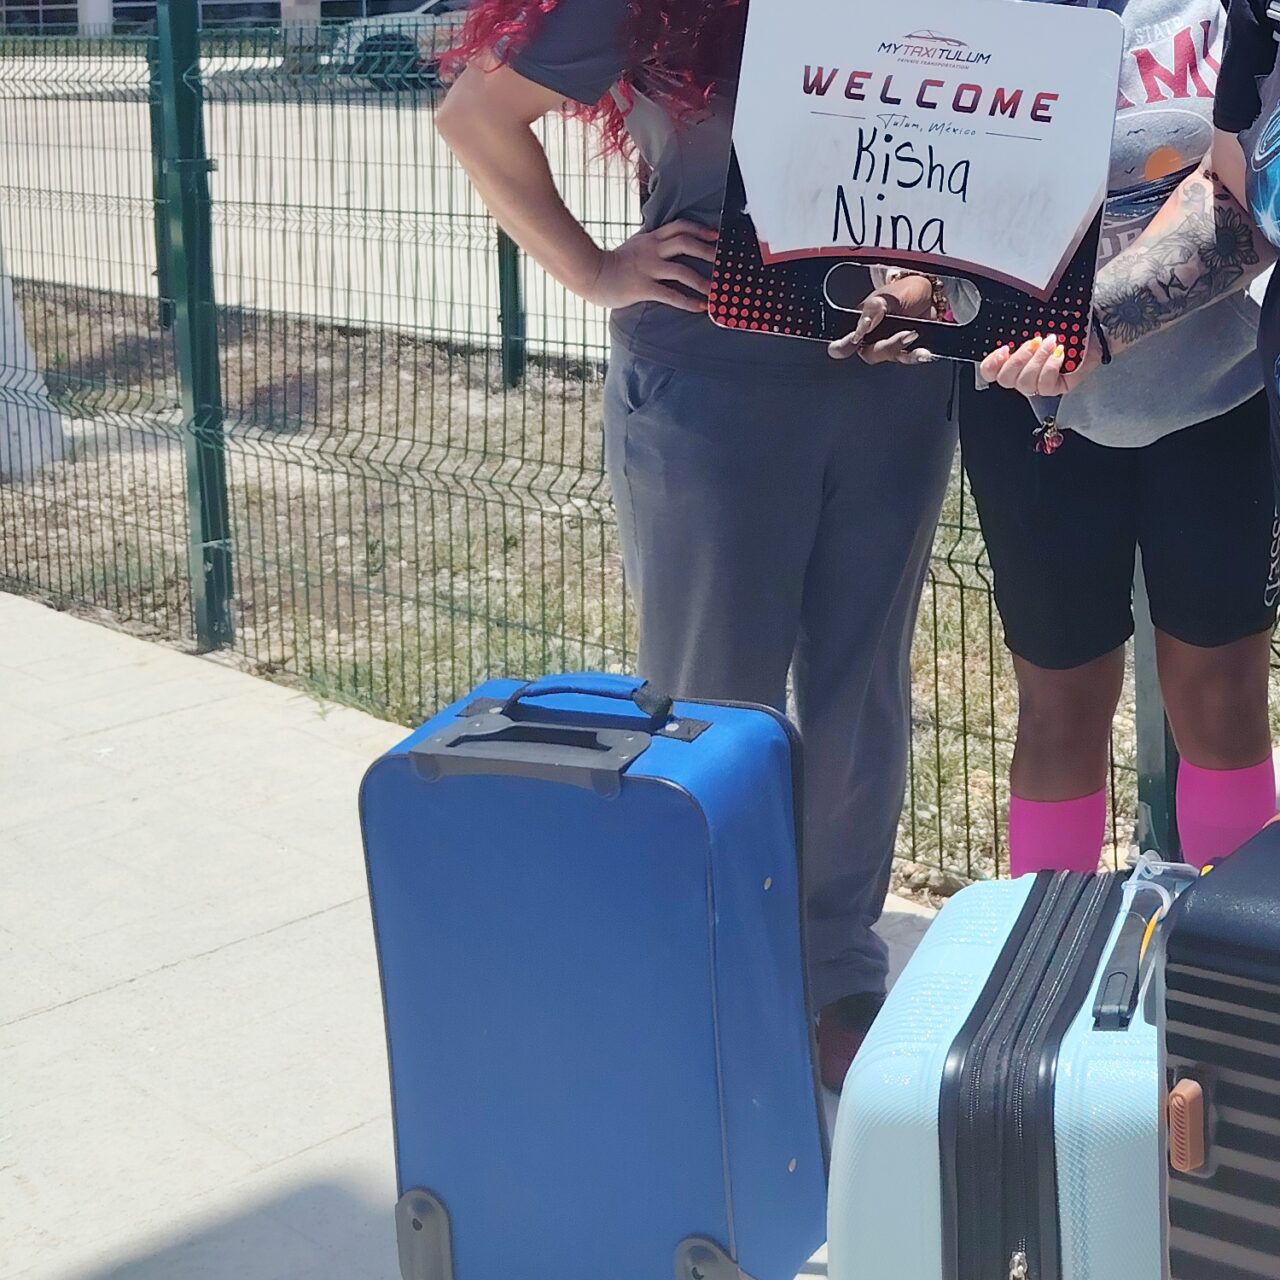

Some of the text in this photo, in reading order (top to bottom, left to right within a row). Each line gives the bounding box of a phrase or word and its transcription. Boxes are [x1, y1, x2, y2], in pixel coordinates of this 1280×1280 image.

[877, 42, 992, 64] MYTAXITULUM
[802, 64, 1060, 123] WELCOME
[833, 184, 947, 254] Nina
